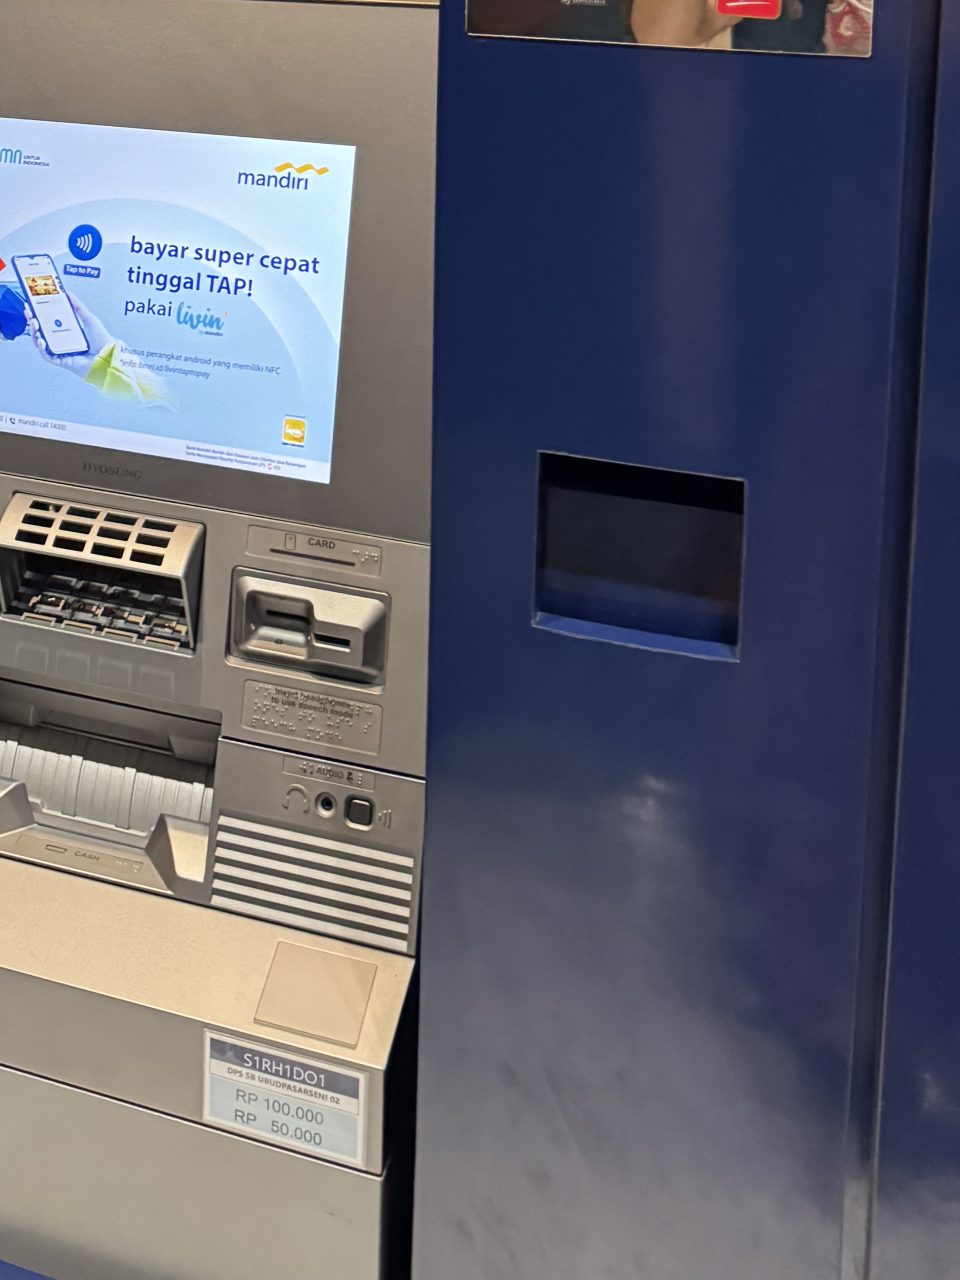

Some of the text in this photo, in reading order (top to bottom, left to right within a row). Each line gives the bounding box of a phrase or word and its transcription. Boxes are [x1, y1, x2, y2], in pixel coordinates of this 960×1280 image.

[237, 170, 309, 191] mandiri
[130, 235, 320, 275] bayar super cepat
[65, 265, 77, 274] Tap
[86, 267, 99, 277] Pay
[127, 266, 254, 297] tinggal TAP!
[124, 298, 172, 317] pakai
[120, 346, 146, 357] khusus
[146, 349, 183, 363] perangkat
[183, 354, 212, 365] android
[213, 359, 231, 370] yang
[264, 365, 282, 375] NFC
[307, 537, 336, 550] CARD
[275, 687, 298, 699] Insert
[281, 699, 296, 708] use
[298, 702, 329, 714] speech
[330, 708, 354, 719] mode
[315, 766, 344, 780] AUDIO
[74, 850, 100, 862] CASH
[227, 1066, 244, 1078] DPS
[329, 1095, 341, 1105] 02
[235, 1088, 325, 1126] RP 100.000
[234, 1108, 323, 1147] RP 50.000
